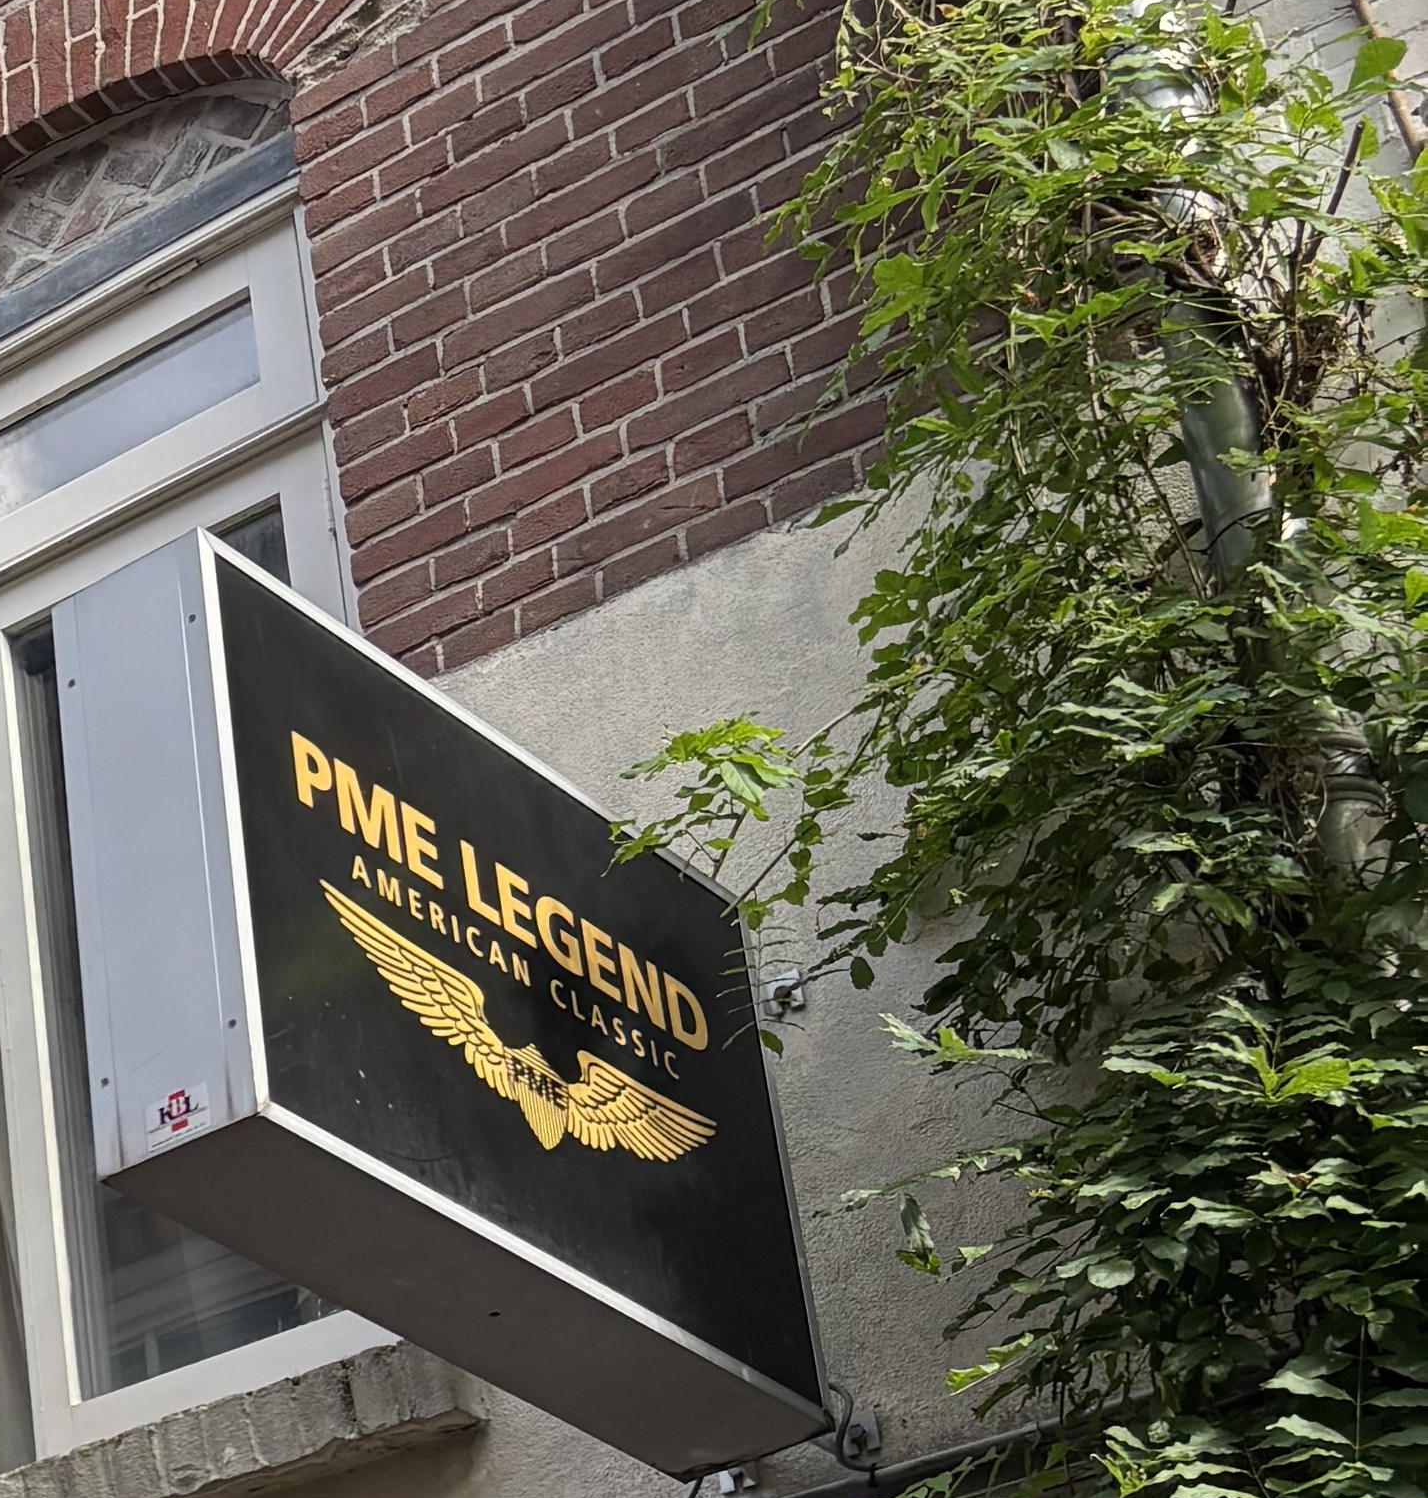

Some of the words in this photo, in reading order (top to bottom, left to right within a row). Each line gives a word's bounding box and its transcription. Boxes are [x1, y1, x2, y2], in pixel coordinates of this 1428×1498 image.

[291, 731, 443, 889] PME
[460, 840, 708, 1051] LEGEND
[352, 855, 531, 987] AMERICAN
[550, 979, 680, 1080] CLASSIC
[512, 1056, 566, 1111] PME
